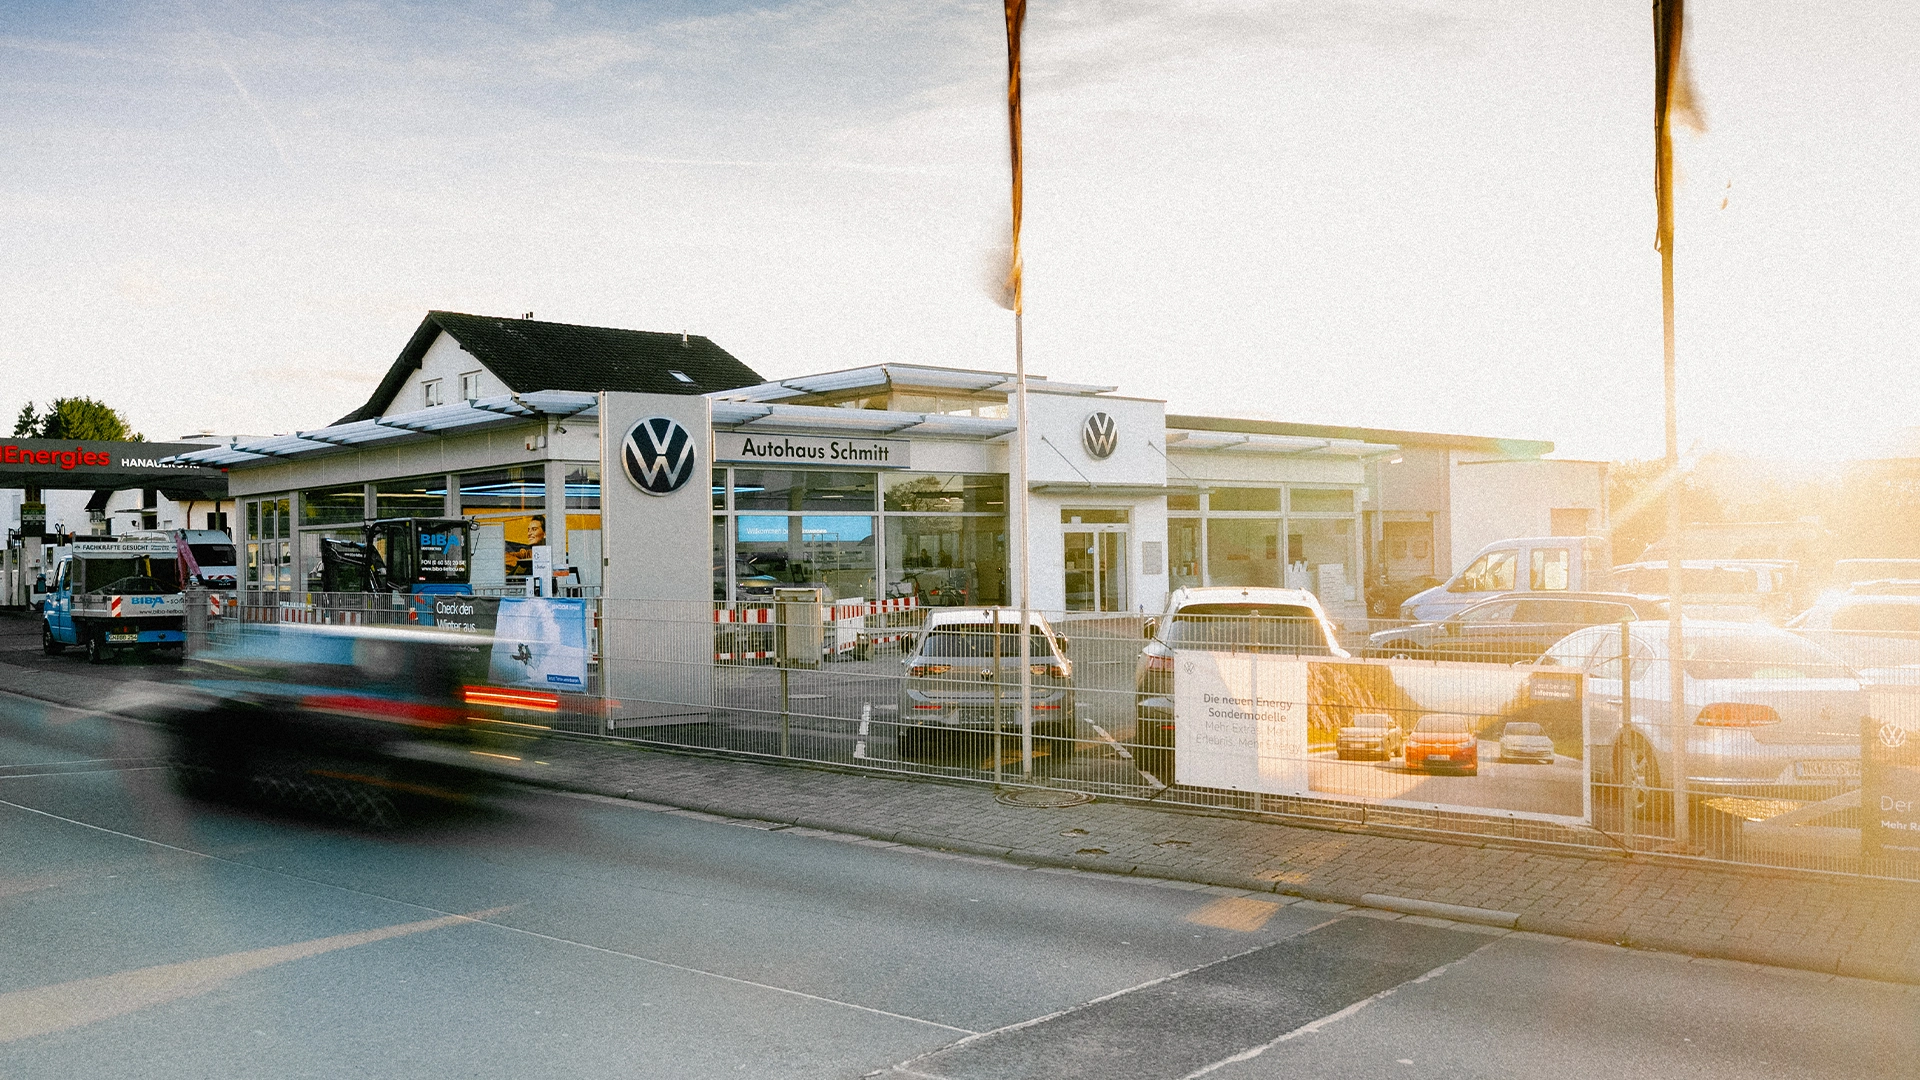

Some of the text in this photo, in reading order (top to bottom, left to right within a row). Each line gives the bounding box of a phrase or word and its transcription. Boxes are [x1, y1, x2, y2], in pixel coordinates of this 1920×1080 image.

[742, 438, 889, 461] Autohaus Schmitt
[82, 543, 121, 551] FACHKRÄFTE
[122, 543, 149, 551] GESUCHT
[421, 533, 460, 555] BIBA
[131, 596, 165, 608] BIBA
[436, 601, 474, 616] Check den
[437, 618, 478, 634] Winter aus.
[1203, 693, 1293, 711] Die neuen Energy
[1208, 707, 1287, 723] Sondermodelle
[1205, 721, 1229, 732] Mehr
[1238, 737, 1263, 749] Mehr
[1267, 740, 1300, 755] Energy
[1880, 795, 1913, 812] Der
[1881, 819, 1908, 831] Mehr
